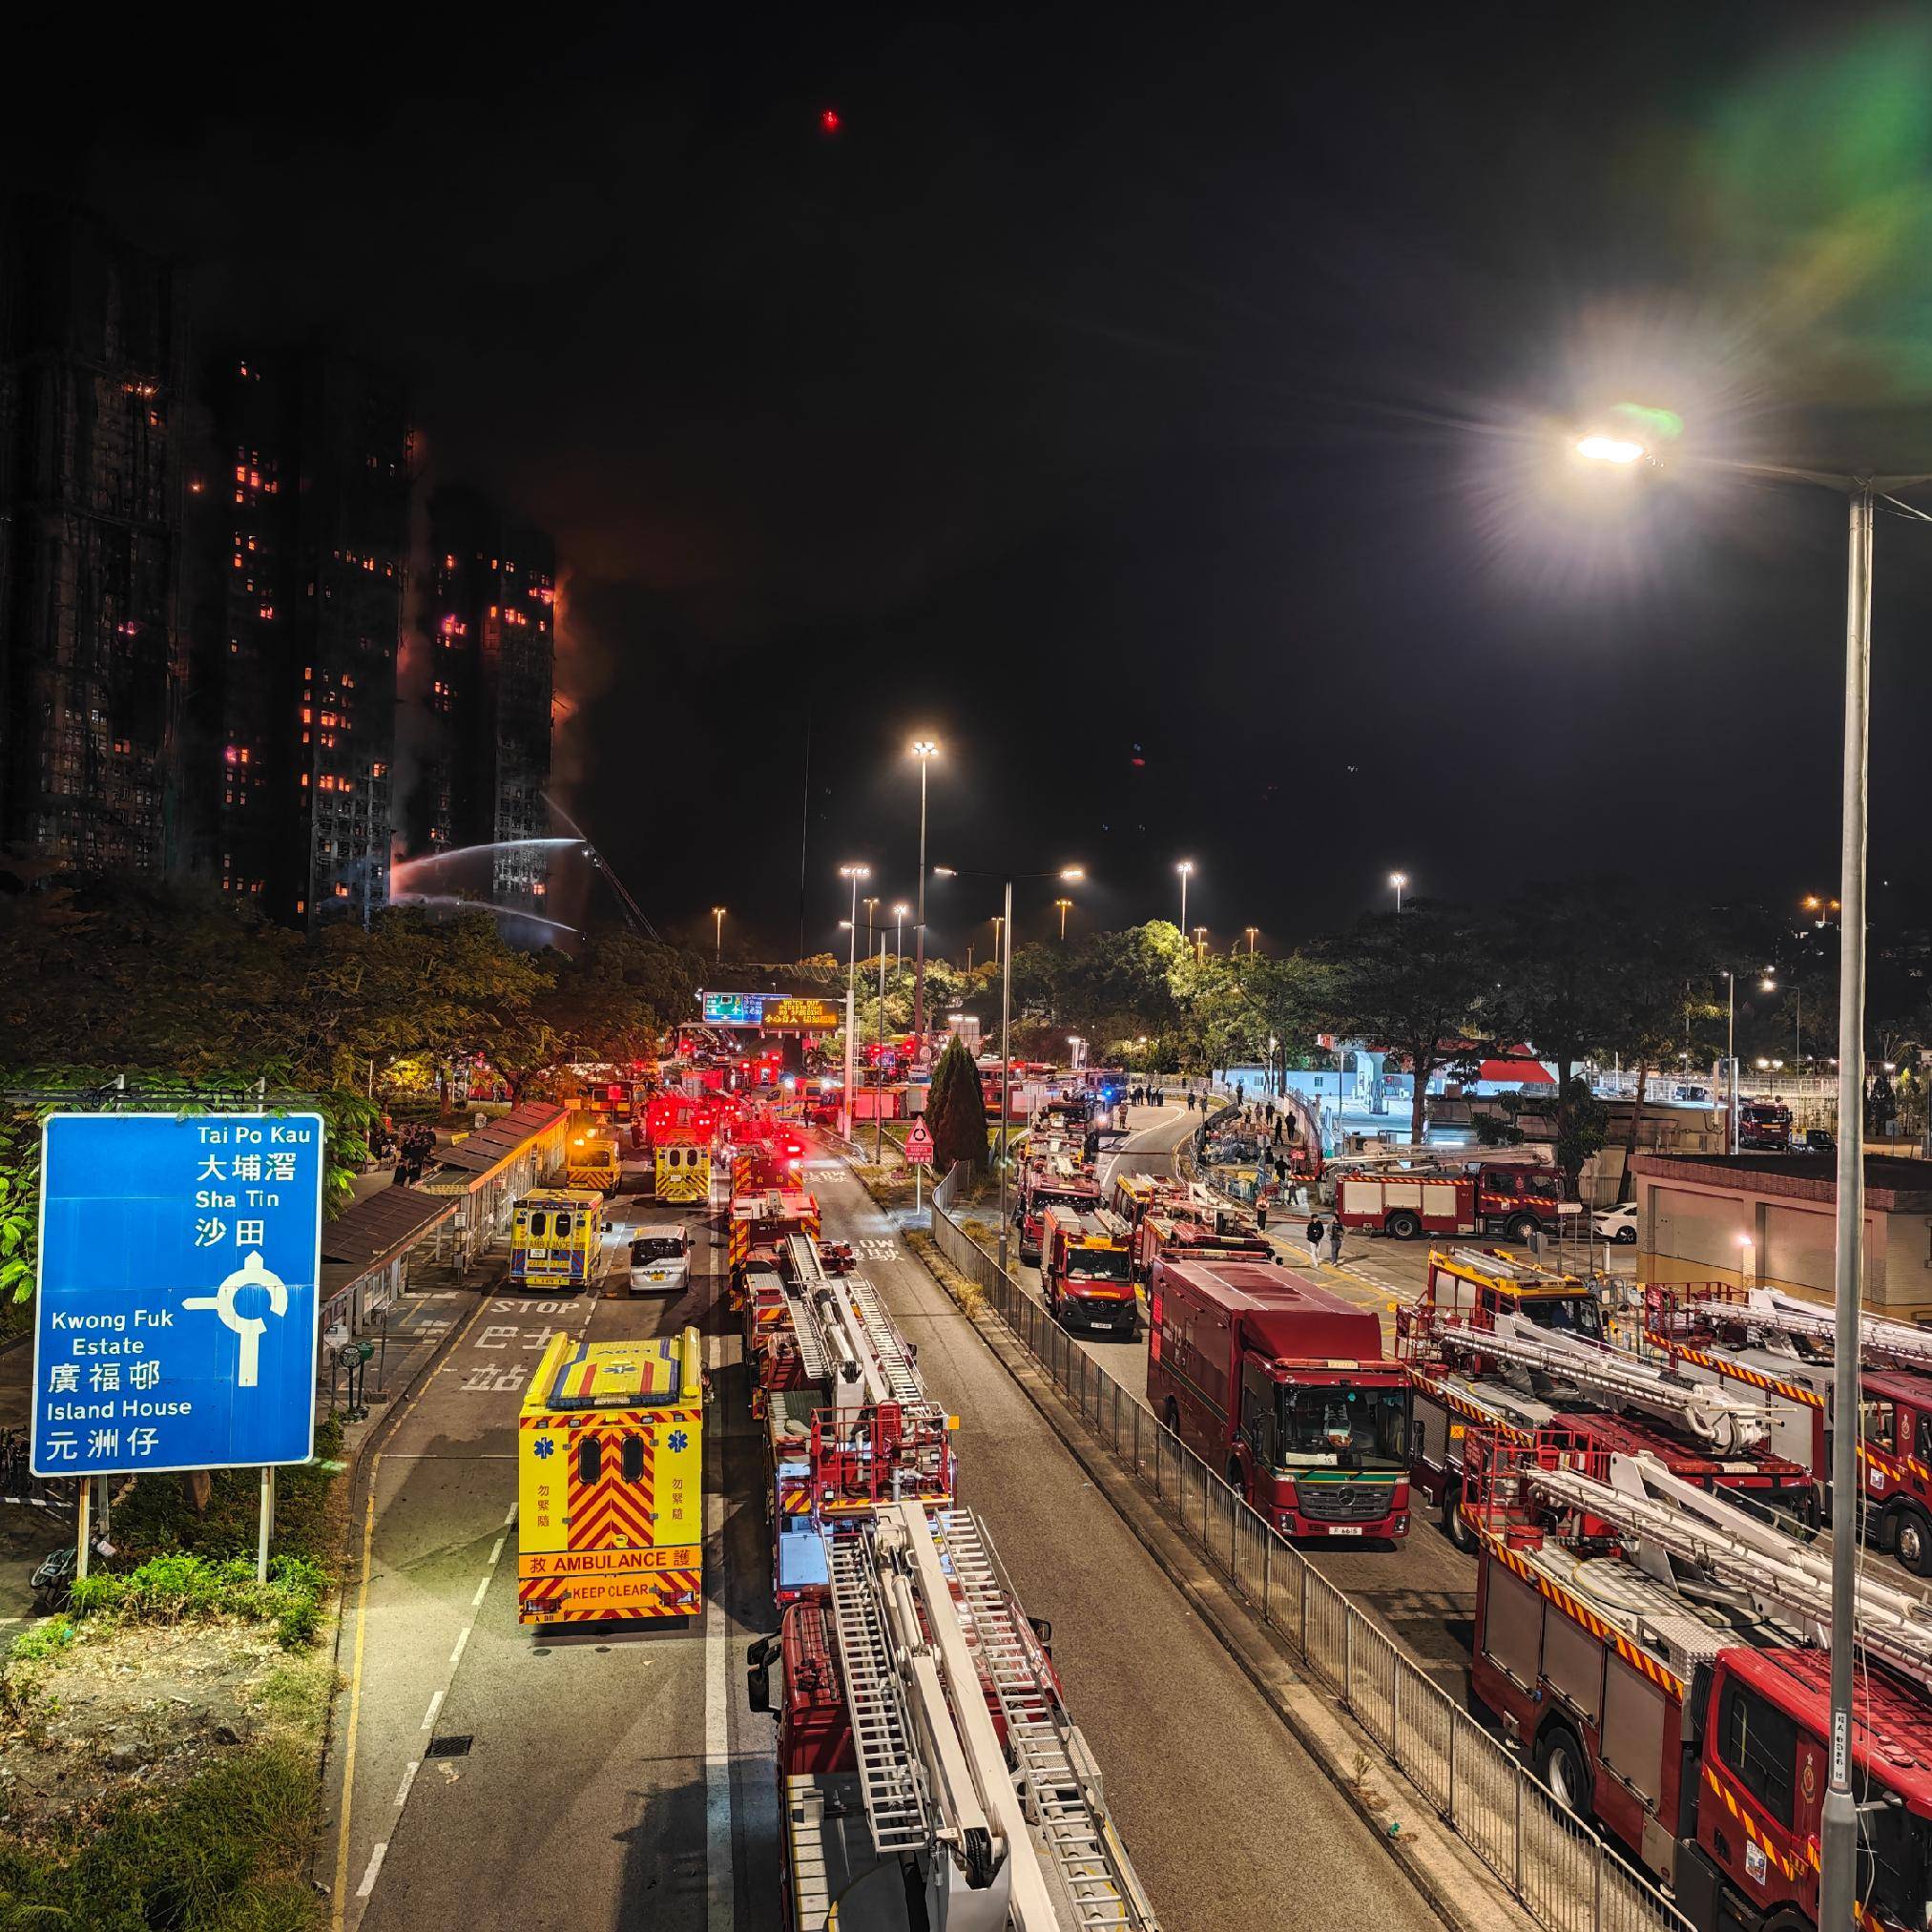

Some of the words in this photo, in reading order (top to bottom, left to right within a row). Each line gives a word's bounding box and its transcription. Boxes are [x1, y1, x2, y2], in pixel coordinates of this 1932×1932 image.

[197, 1126, 228, 1144] Tai
[235, 1126, 262, 1144] Po
[270, 1126, 311, 1144] Kau
[196, 1152, 297, 1182] 大埔滘
[195, 1190, 237, 1209] Sha
[245, 1190, 280, 1208] Tin
[194, 1218, 265, 1247] 沙田
[529, 1238, 571, 1249] AMBULANCE
[489, 1300, 580, 1314] STOP
[52, 1312, 126, 1332] Kwong
[134, 1309, 175, 1327] Fuk
[73, 1339, 145, 1356] Estate
[48, 1361, 160, 1394] 廣福邨
[459, 1362, 529, 1391] 站
[47, 1401, 114, 1422] Island
[122, 1399, 193, 1418] House
[46, 1426, 160, 1462] 元洲仔
[537, 1485, 550, 1527] 勿緊隨
[672, 1479, 683, 1520] 勿緊隨
[530, 1557, 547, 1573] 救
[553, 1551, 667, 1572] AMBULANCE
[674, 1548, 691, 1567] 護
[572, 1587, 606, 1600] KEEP
[608, 1583, 650, 1598] CLEAR
